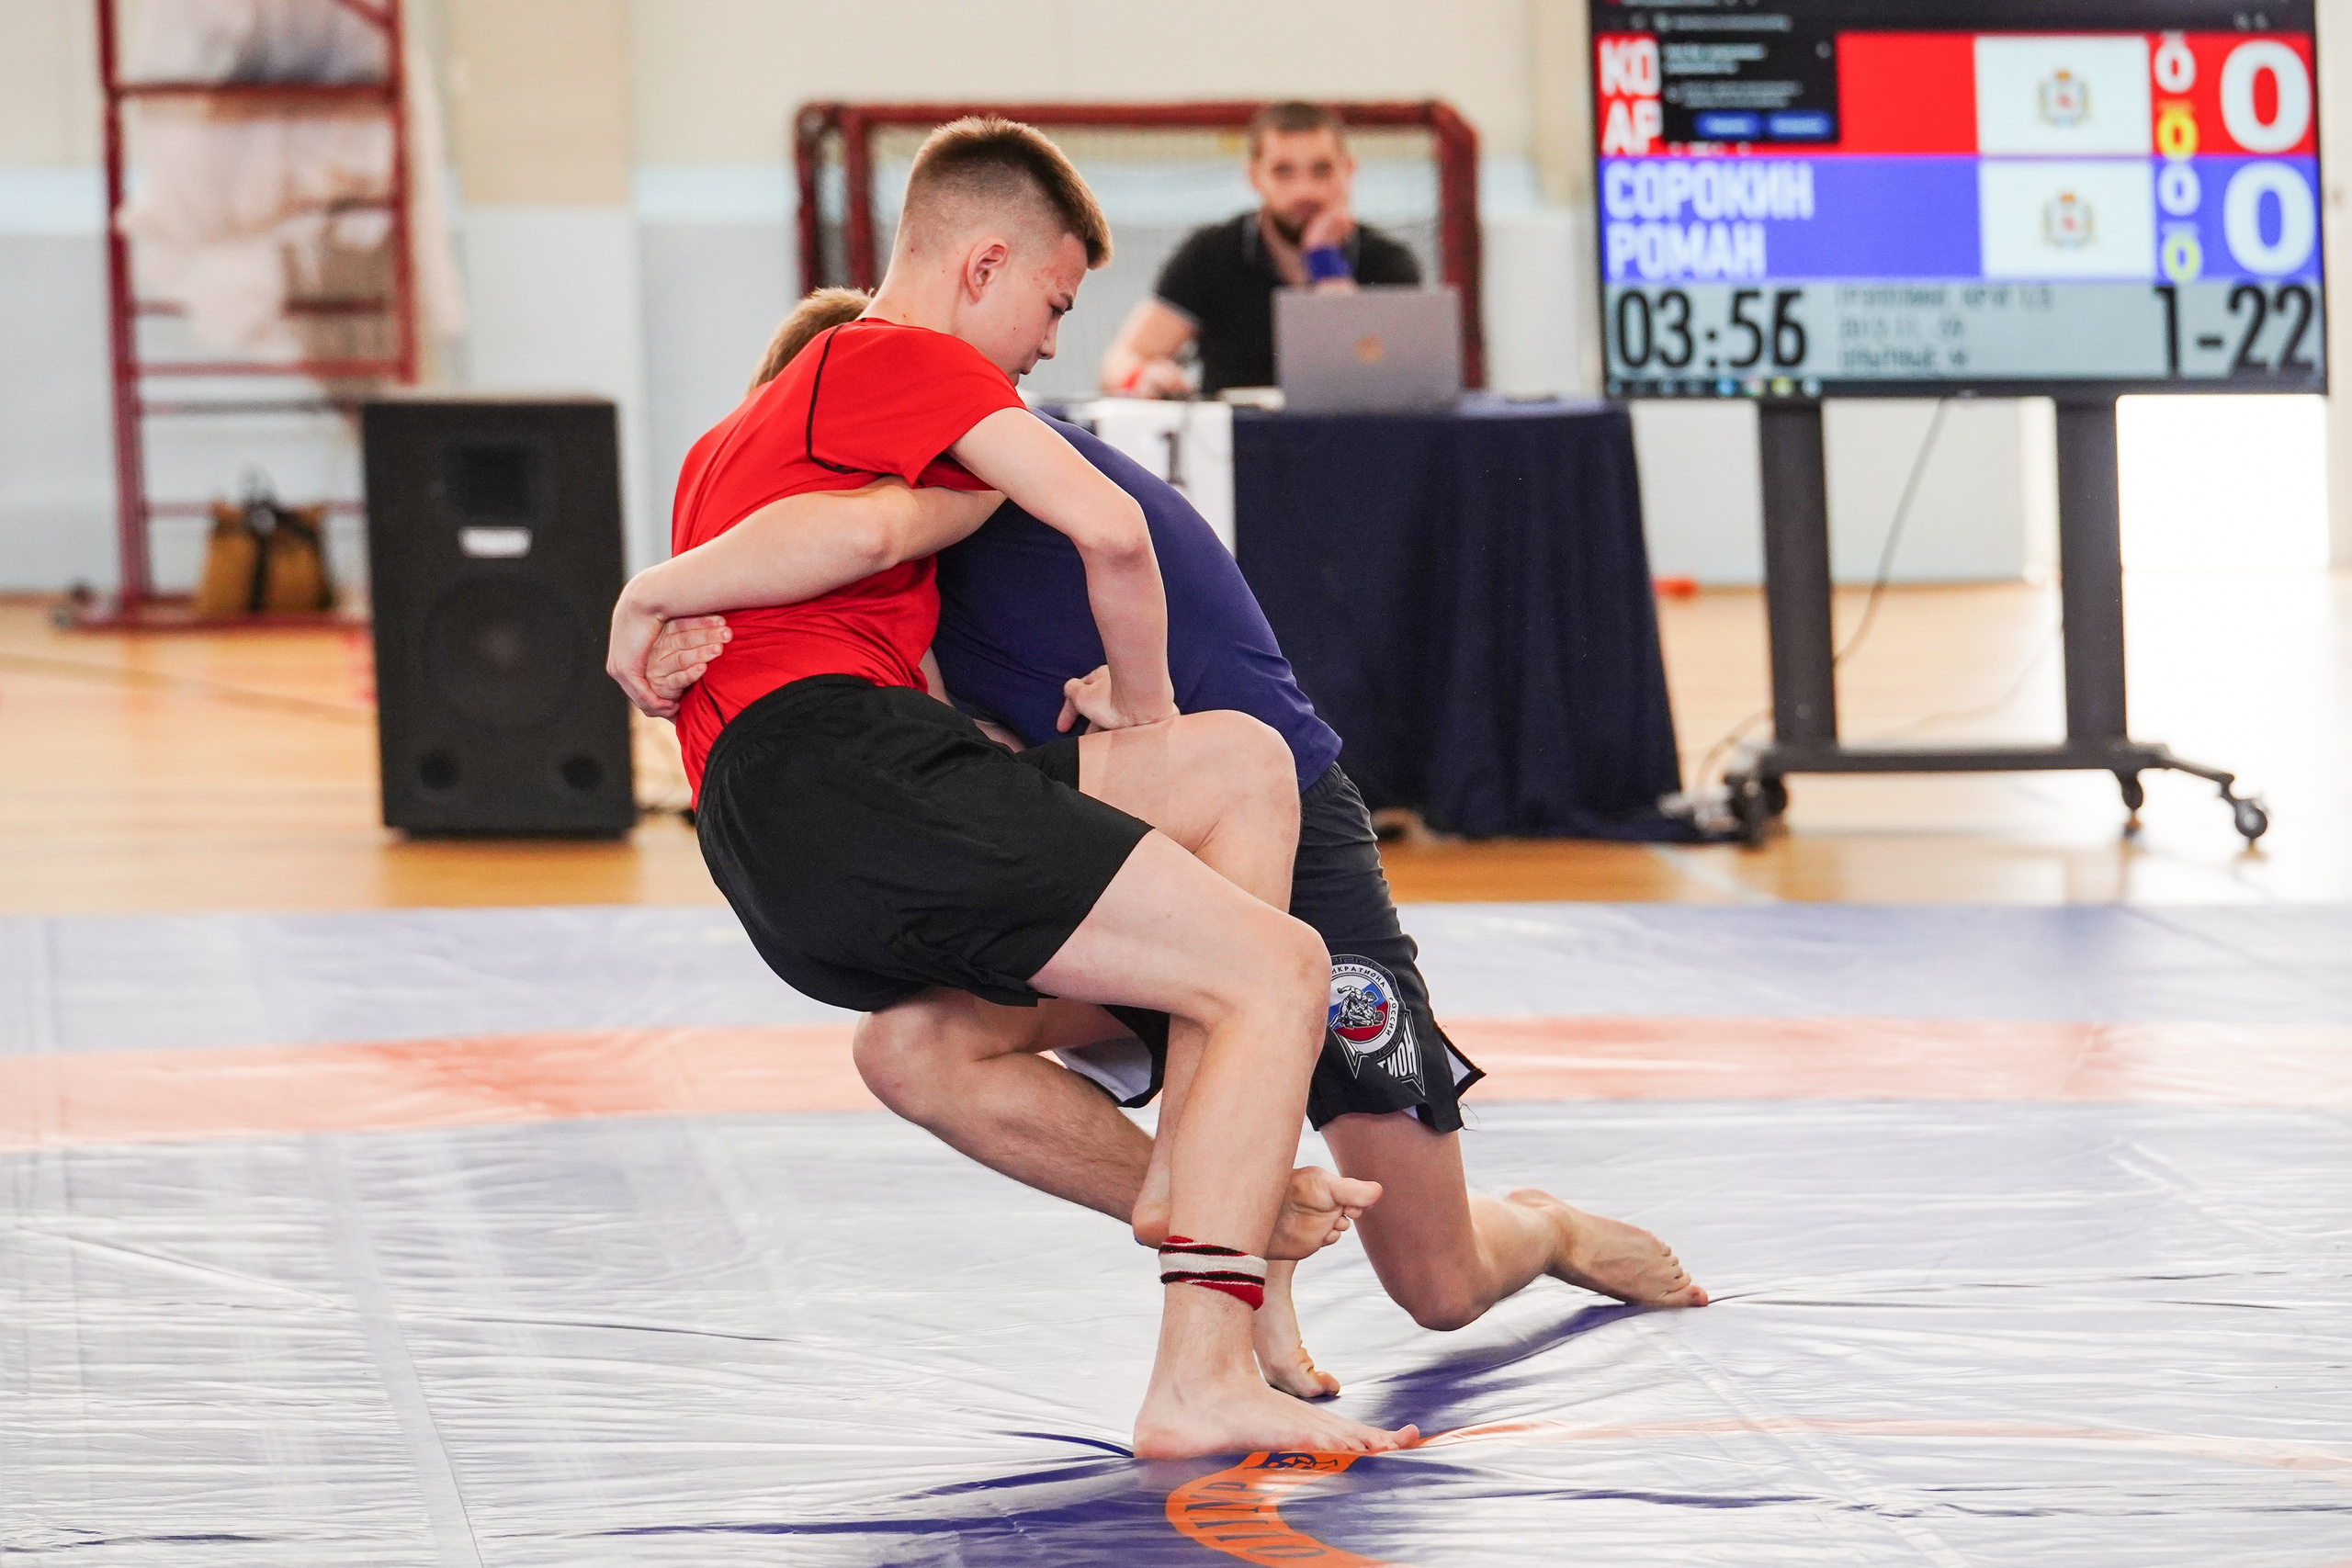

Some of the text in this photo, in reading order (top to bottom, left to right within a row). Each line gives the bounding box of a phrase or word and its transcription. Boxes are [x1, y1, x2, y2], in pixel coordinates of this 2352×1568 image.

[2220, 39, 2312, 153] 0
[1604, 161, 1815, 221] СОРОКИН
[2223, 161, 2316, 276] 0
[1607, 221, 1768, 278] РОМАН
[1617, 288, 1808, 369] 03:56
[2153, 284, 2315, 376] 1-22
[1331, 965, 1386, 988] НКРАТИОНА
